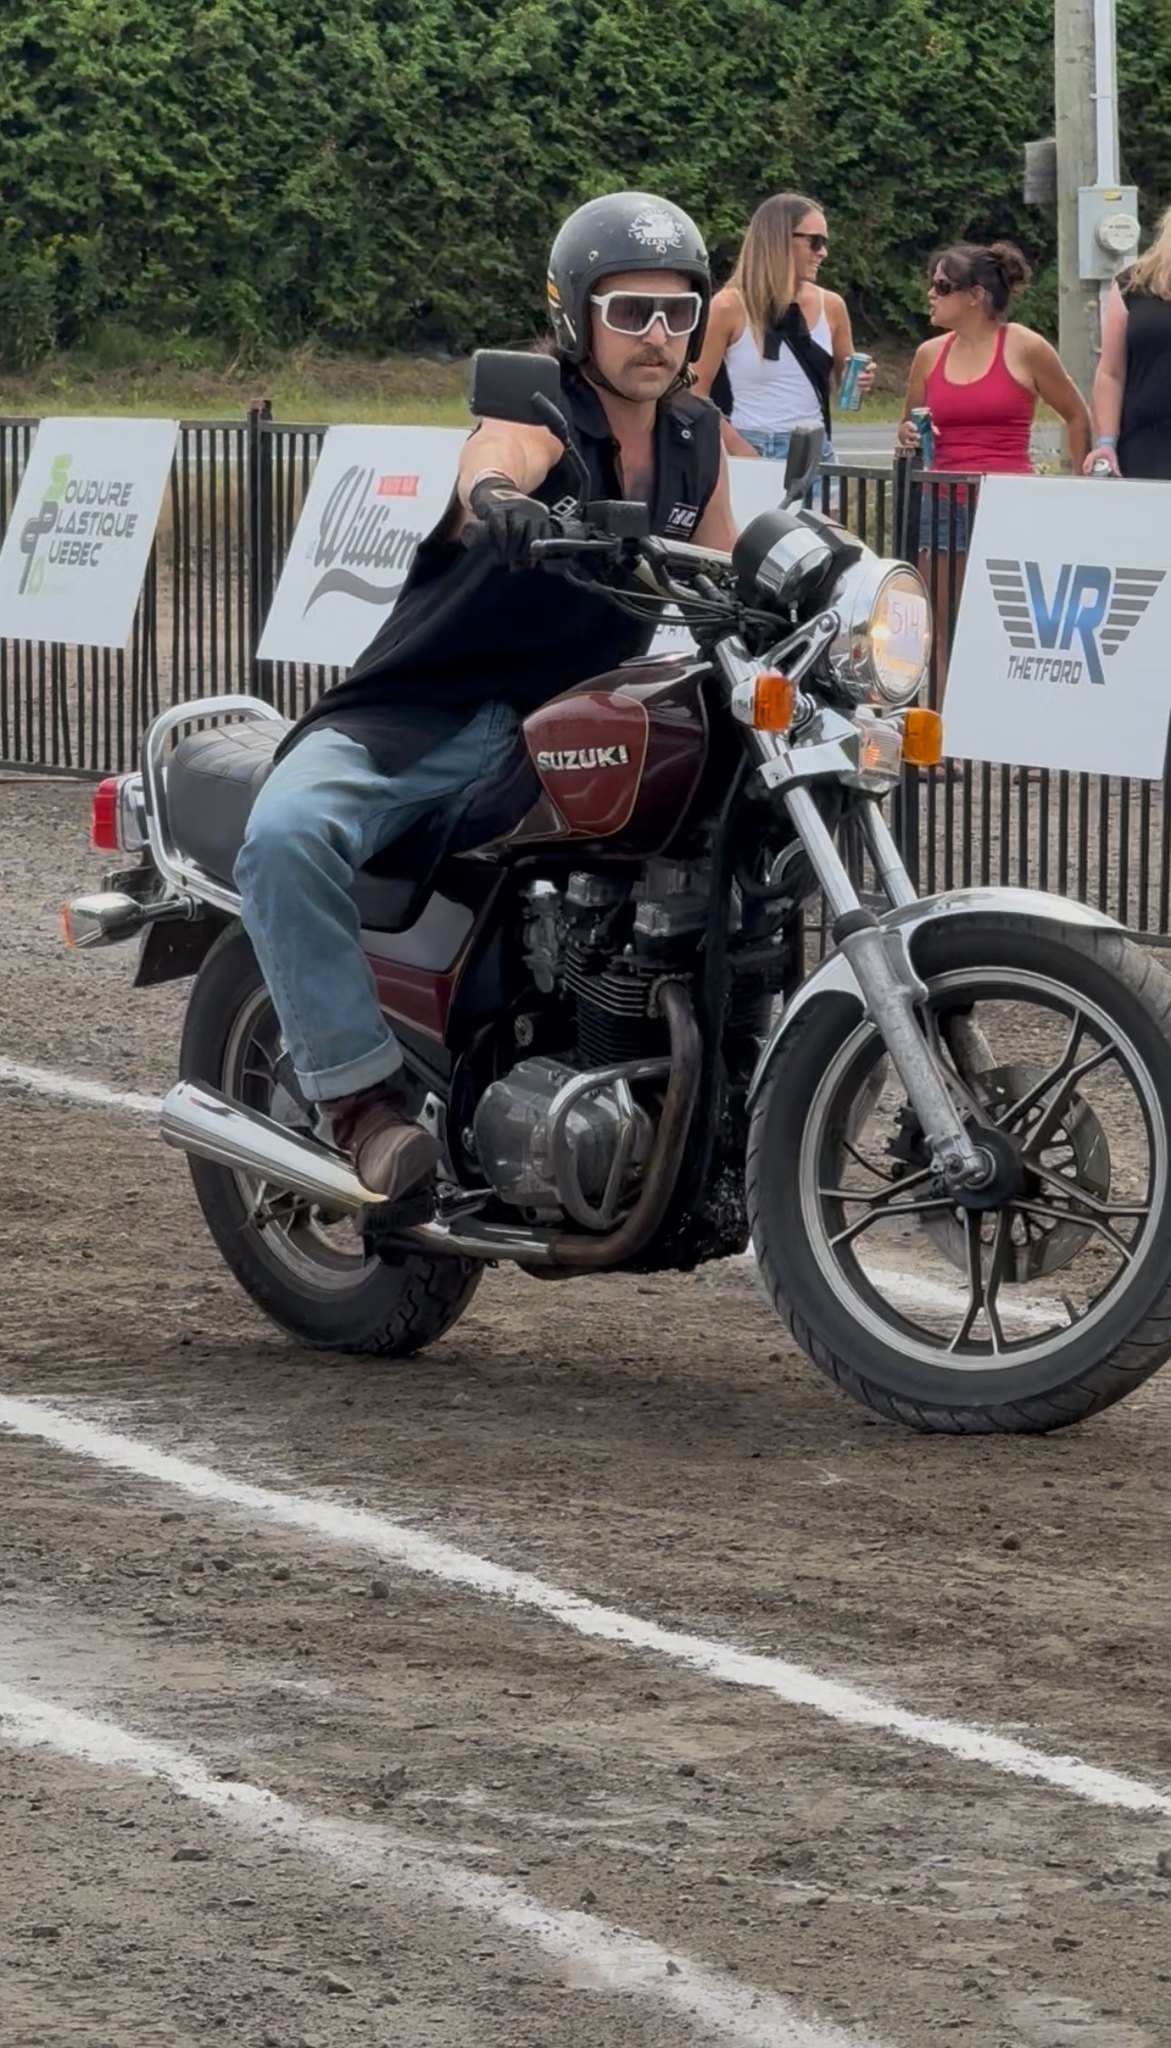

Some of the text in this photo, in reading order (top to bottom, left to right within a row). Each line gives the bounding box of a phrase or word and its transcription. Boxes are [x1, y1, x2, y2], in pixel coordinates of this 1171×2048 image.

[1024, 561, 1105, 685] VR
[1006, 655, 1083, 684] THETFORD
[537, 744, 630, 771] SUZUKI
